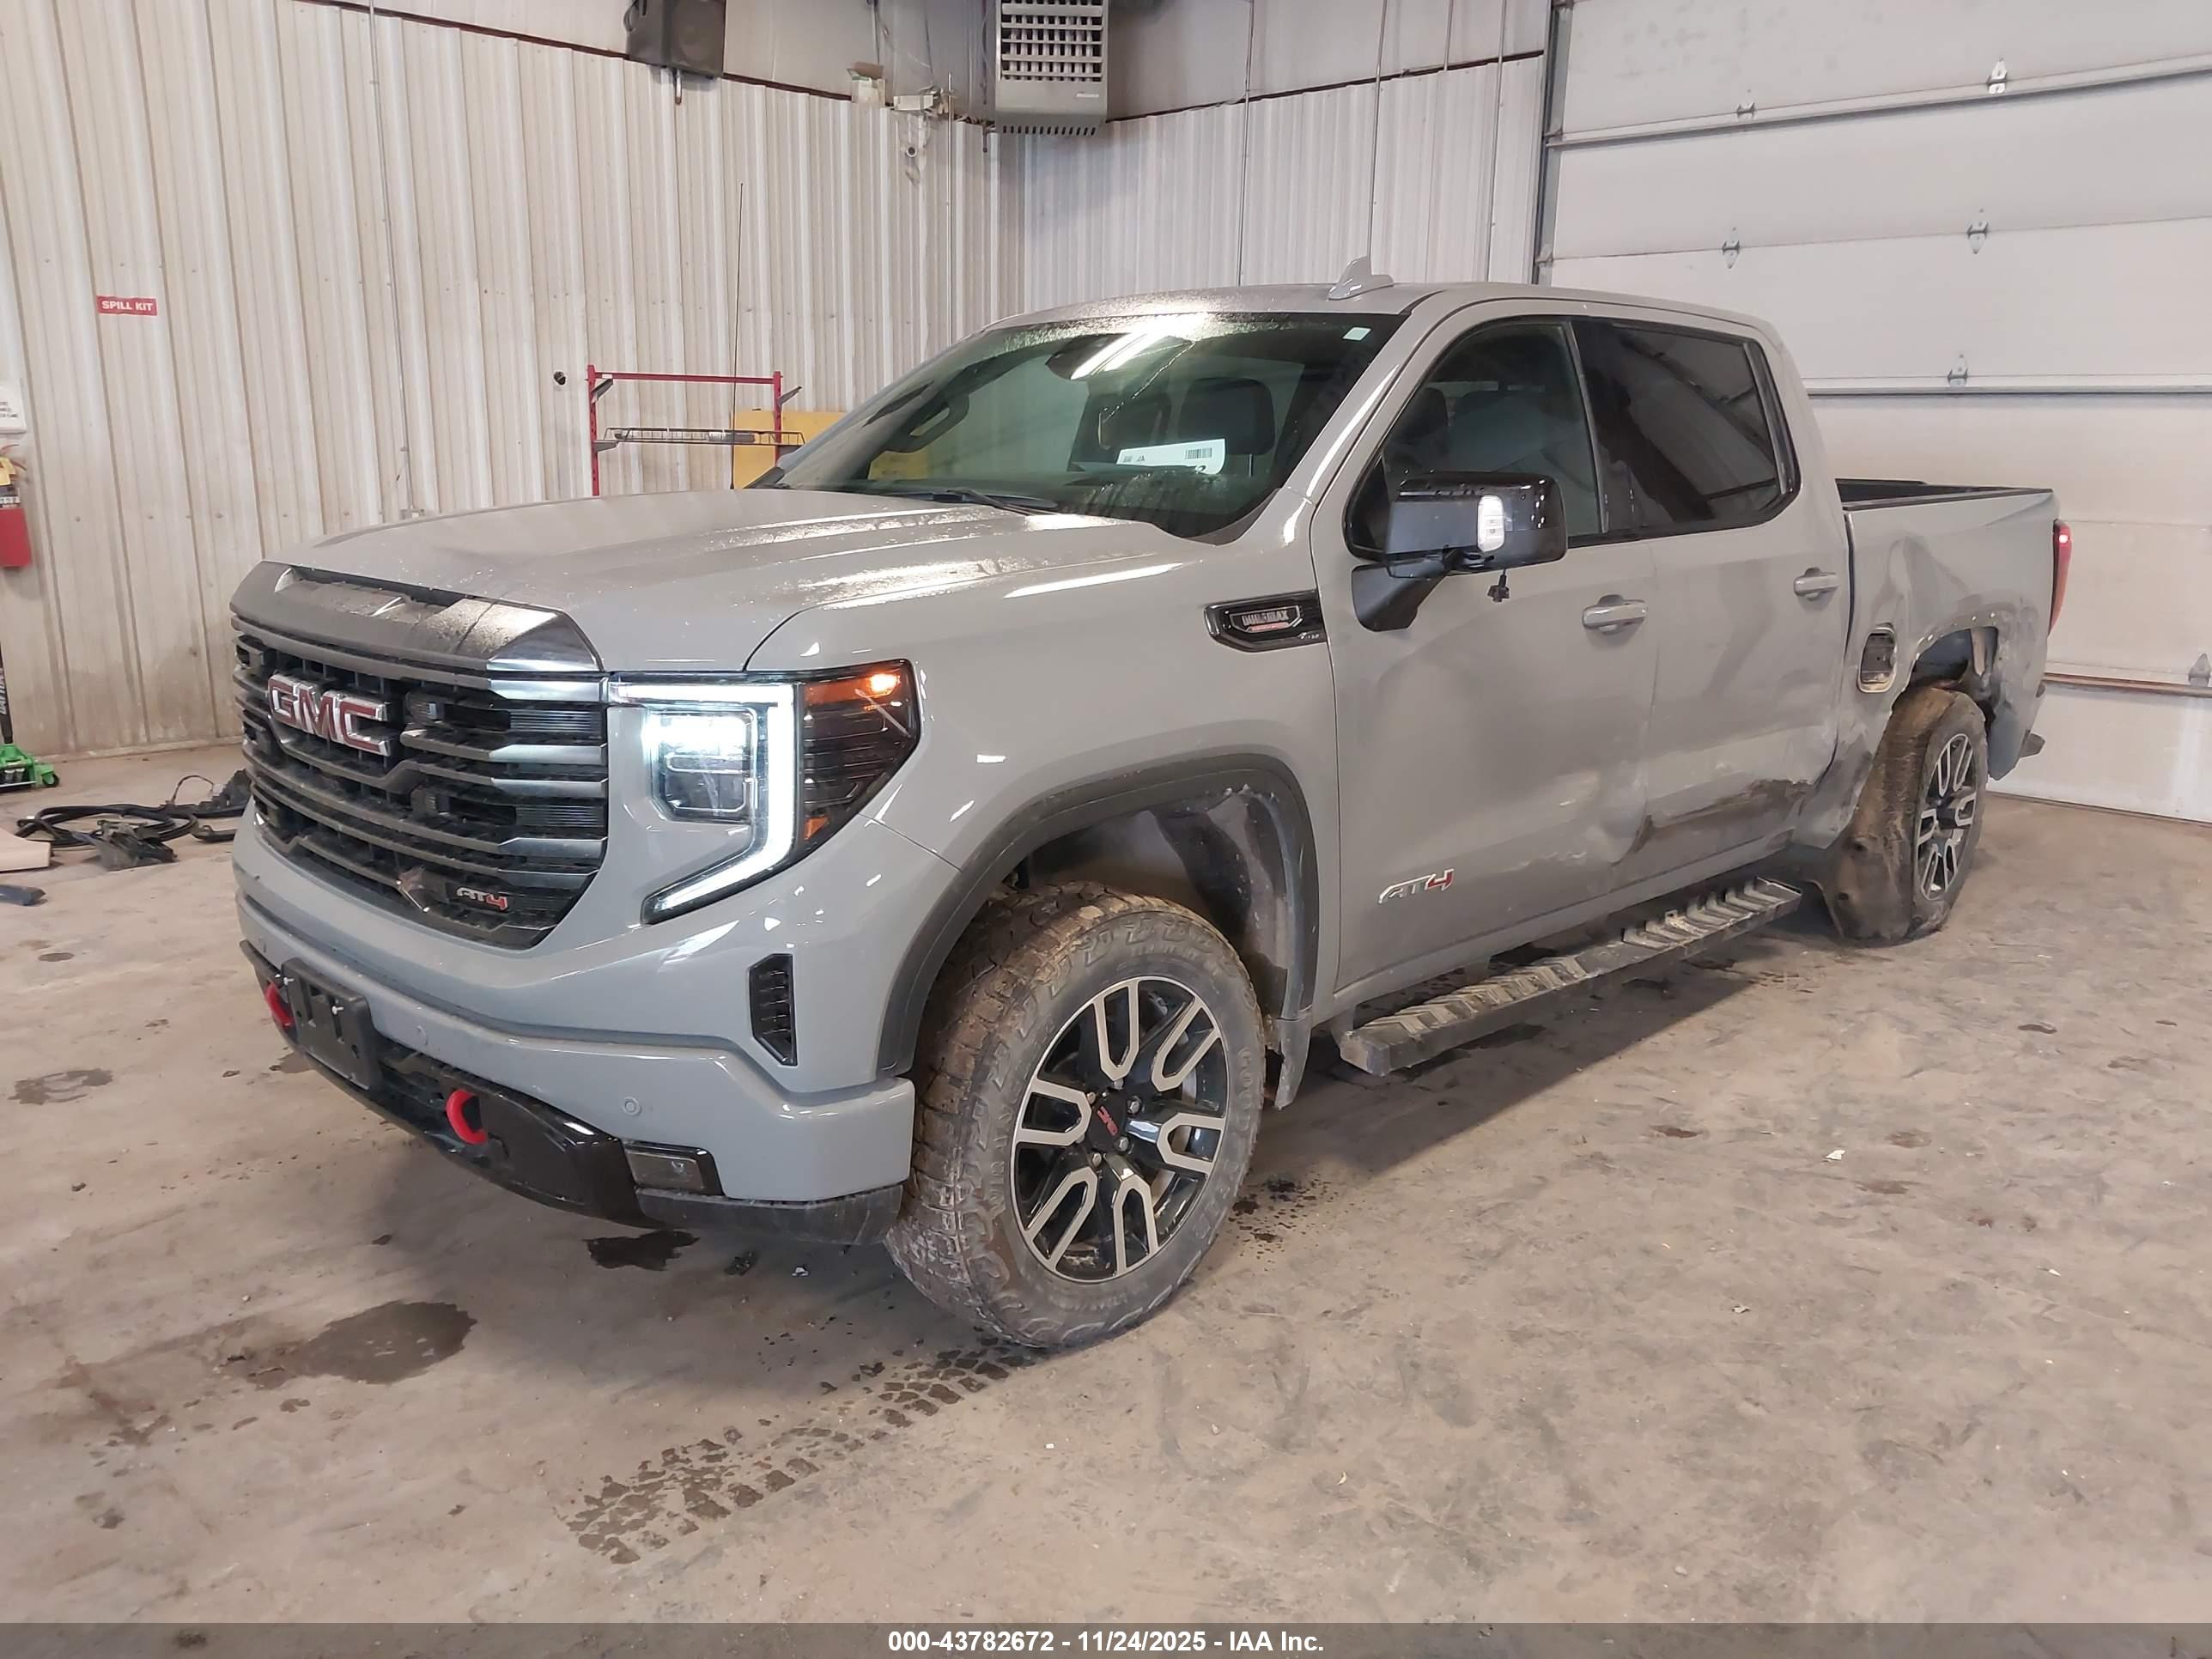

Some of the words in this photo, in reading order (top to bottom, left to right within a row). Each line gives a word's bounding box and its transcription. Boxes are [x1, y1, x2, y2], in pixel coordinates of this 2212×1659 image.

[101, 300, 133, 310] SPILL
[135, 301, 154, 311] KIT
[268, 673, 391, 757] GMC
[456, 887, 508, 911] AT4
[1377, 868, 1455, 904] AT4
